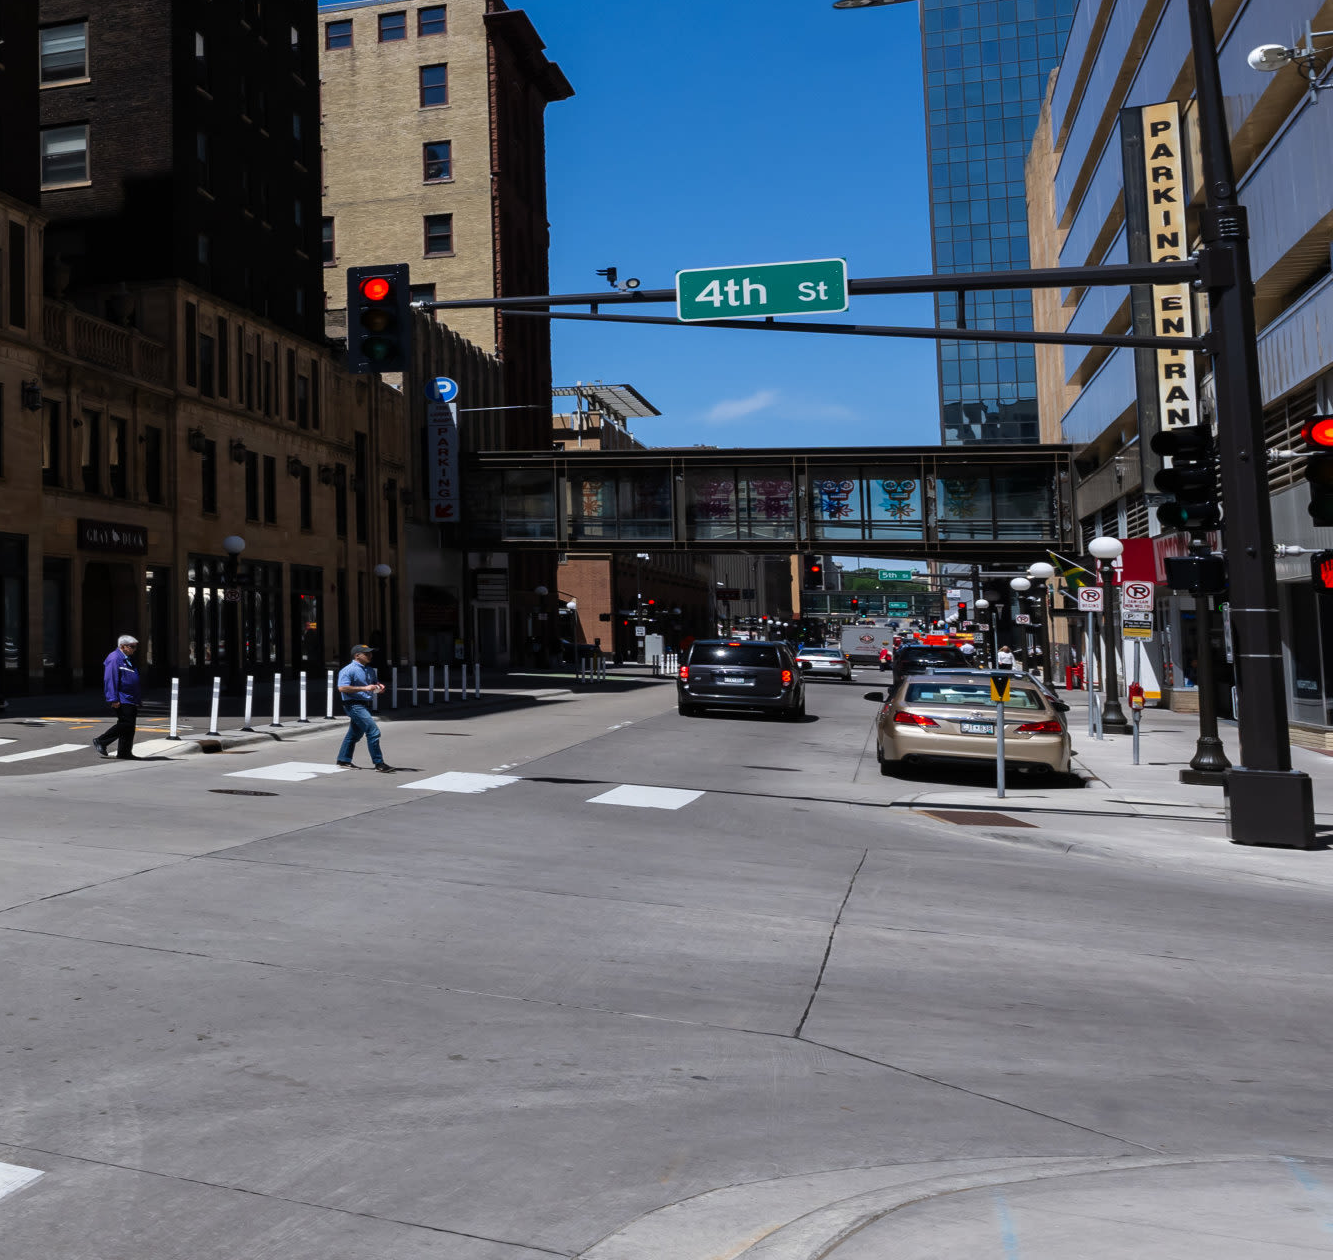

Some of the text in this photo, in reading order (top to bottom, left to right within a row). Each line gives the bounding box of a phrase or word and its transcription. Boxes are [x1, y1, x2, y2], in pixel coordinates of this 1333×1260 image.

[1149, 120, 1181, 263] PARKIN
[694, 277, 829, 307] 4th St
[437, 427, 451, 498] PARKING
